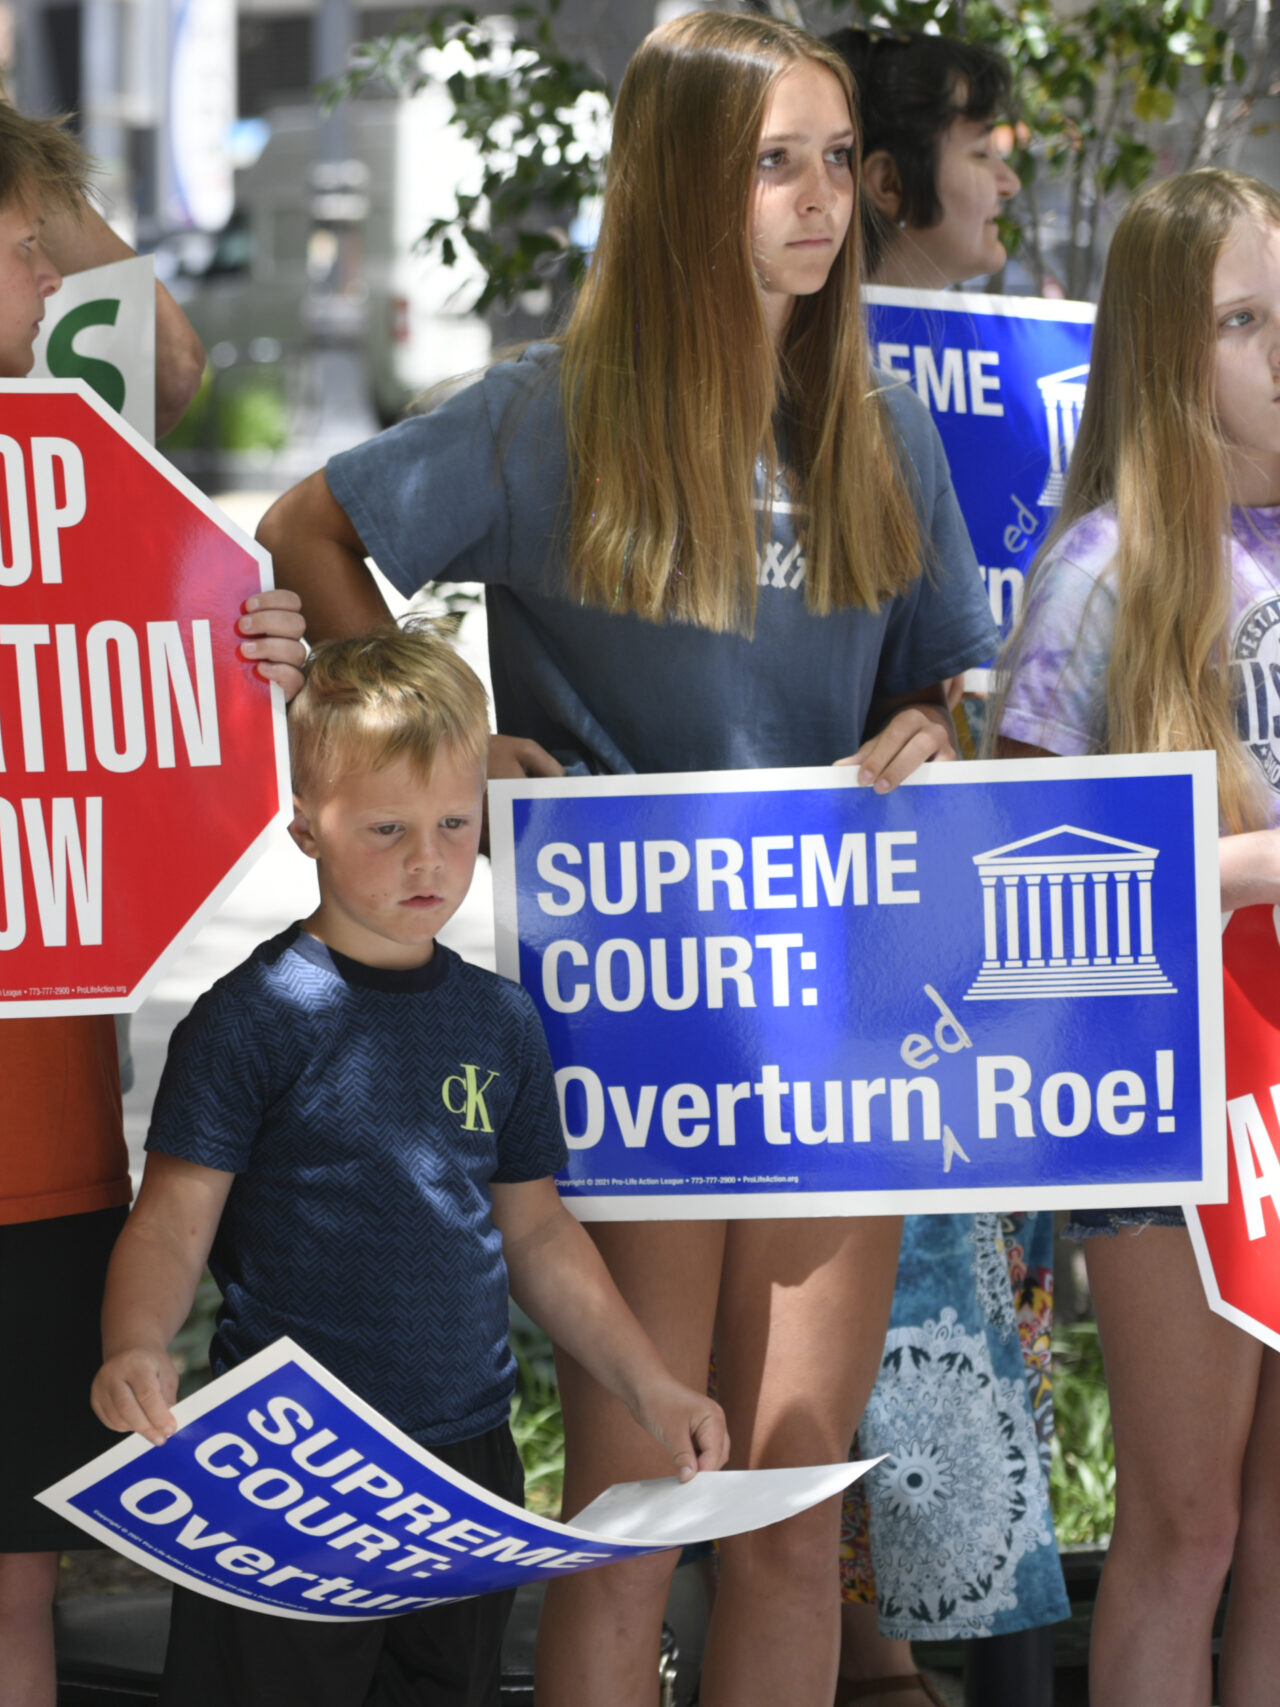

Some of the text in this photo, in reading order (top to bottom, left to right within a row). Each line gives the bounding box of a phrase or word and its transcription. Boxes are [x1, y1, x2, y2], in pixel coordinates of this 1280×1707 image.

[1004, 494, 1038, 553] ed
[536, 830, 920, 916] SUPREME
[2, 988, 23, 998] League
[76, 985, 127, 995] ProLifeAction.org
[543, 933, 818, 1013] COURT:
[900, 983, 973, 1070] ed
[554, 1050, 1175, 1149] Overturn Roe!
[555, 1178, 585, 1188] Copyright
[594, 1178, 610, 1186] 2021
[611, 1177, 637, 1186] Pro-Life
[638, 1177, 659, 1186] Action
[660, 1177, 684, 1187] League
[691, 1176, 736, 1185] 773-777-2900
[743, 1175, 799, 1185] ProLifeAction.org
[1227, 1082, 1280, 1242] A
[194, 1432, 452, 1578] COURT:
[248, 1396, 613, 1568] SUPREME
